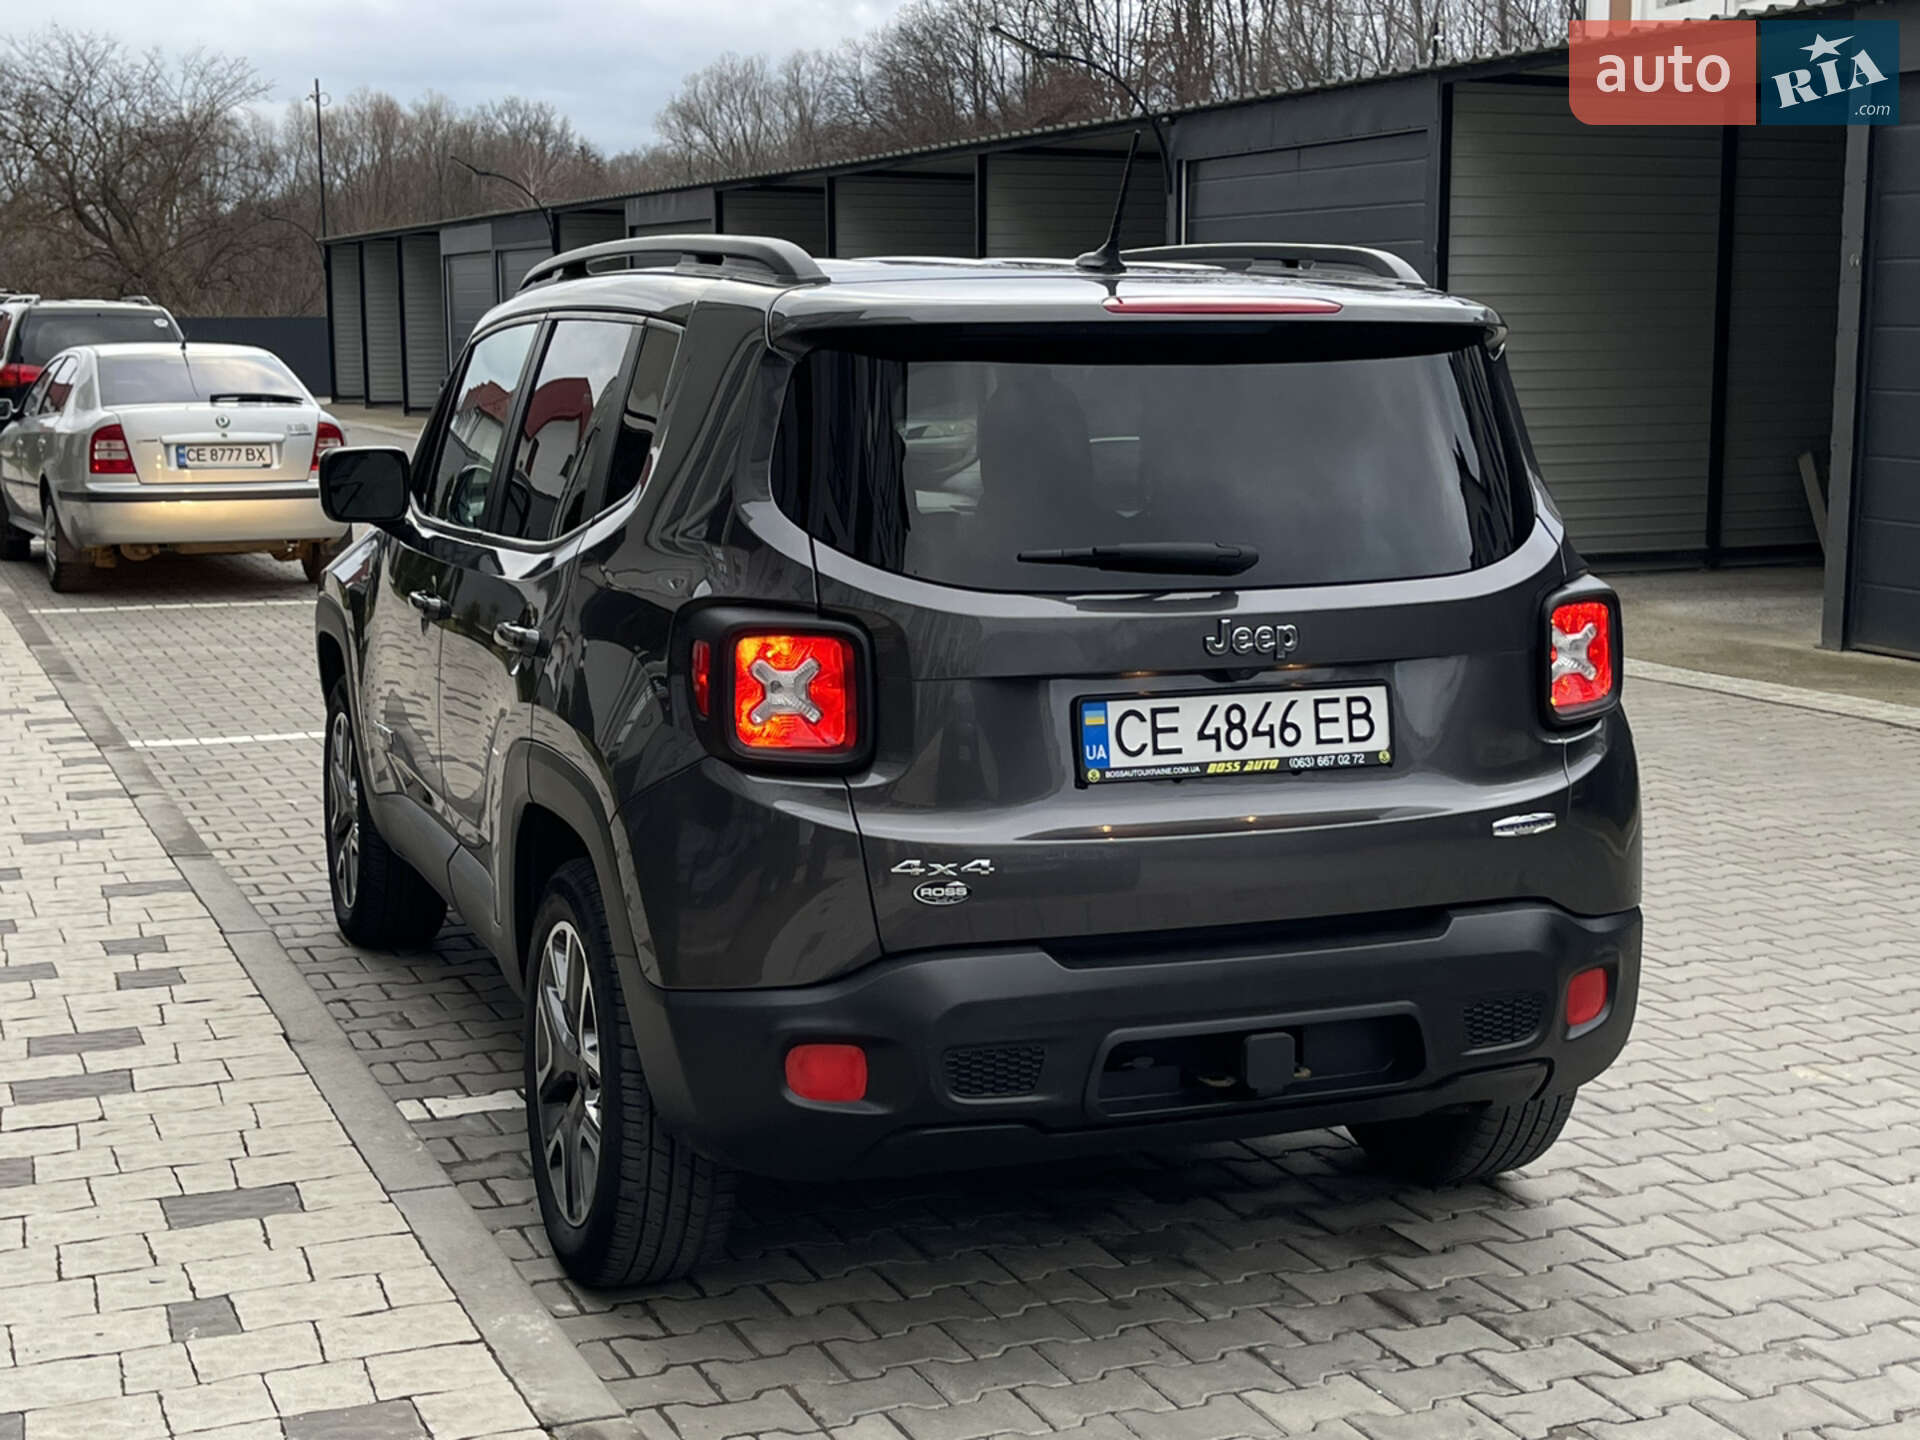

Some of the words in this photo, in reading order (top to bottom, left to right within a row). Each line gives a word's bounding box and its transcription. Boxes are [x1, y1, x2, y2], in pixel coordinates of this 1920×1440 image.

[186, 447, 206, 462] CE
[210, 447, 242, 462] 8777
[245, 447, 266, 462] BX
[1204, 617, 1298, 659] Jeep
[1114, 706, 1183, 758] CE
[1197, 699, 1302, 753] 4846
[1313, 695, 1376, 745] EB
[1085, 744, 1107, 762] UA
[1206, 760, 1241, 774] BOSS
[1243, 759, 1280, 772] AUTO
[1289, 756, 1315, 769] (063)
[1353, 753, 1365, 764] 72
